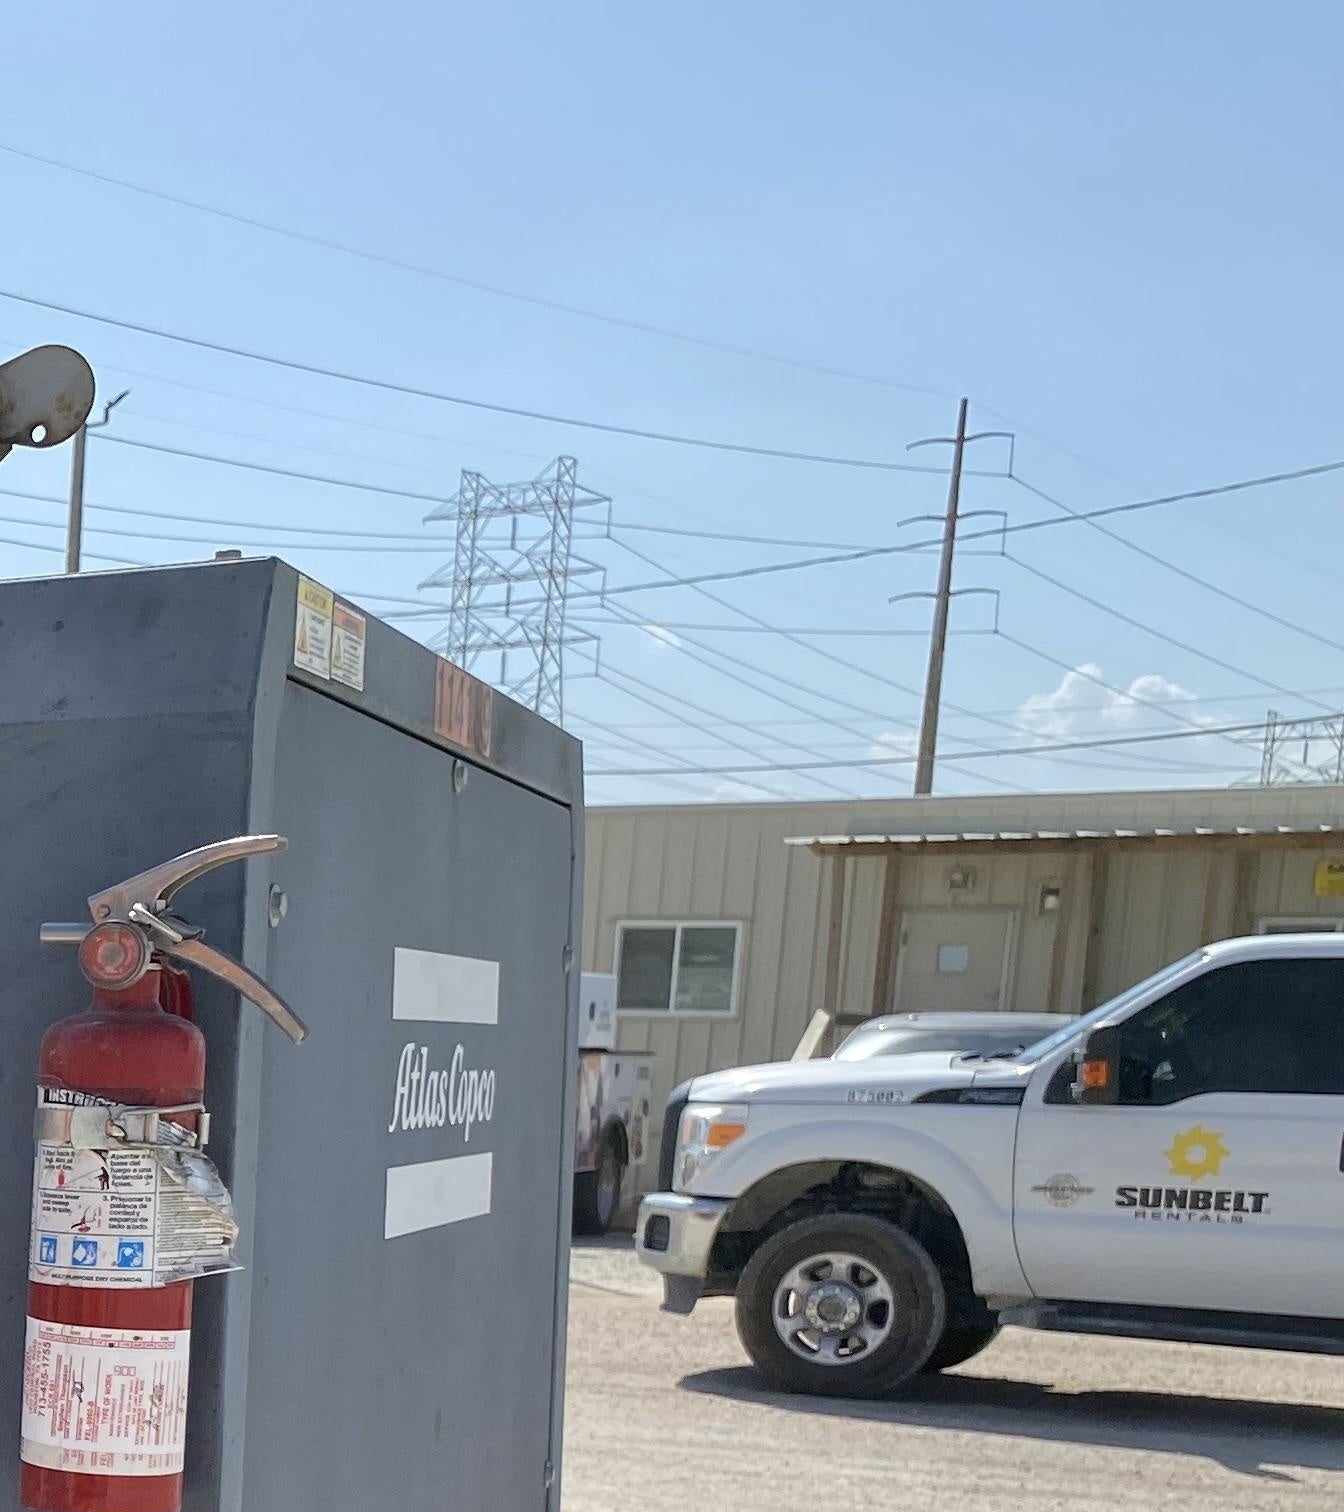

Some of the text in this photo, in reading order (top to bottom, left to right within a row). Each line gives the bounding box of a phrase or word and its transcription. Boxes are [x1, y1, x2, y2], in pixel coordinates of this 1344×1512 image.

[388, 1042, 495, 1142] Atlas Copco
[1115, 1187, 1269, 1214] SUNBELT
[1134, 1210, 1243, 1224] RENTALS
[38, 1341, 52, 1417] 713-455-1755
[101, 1374, 112, 1425] TYPE OF WORK
